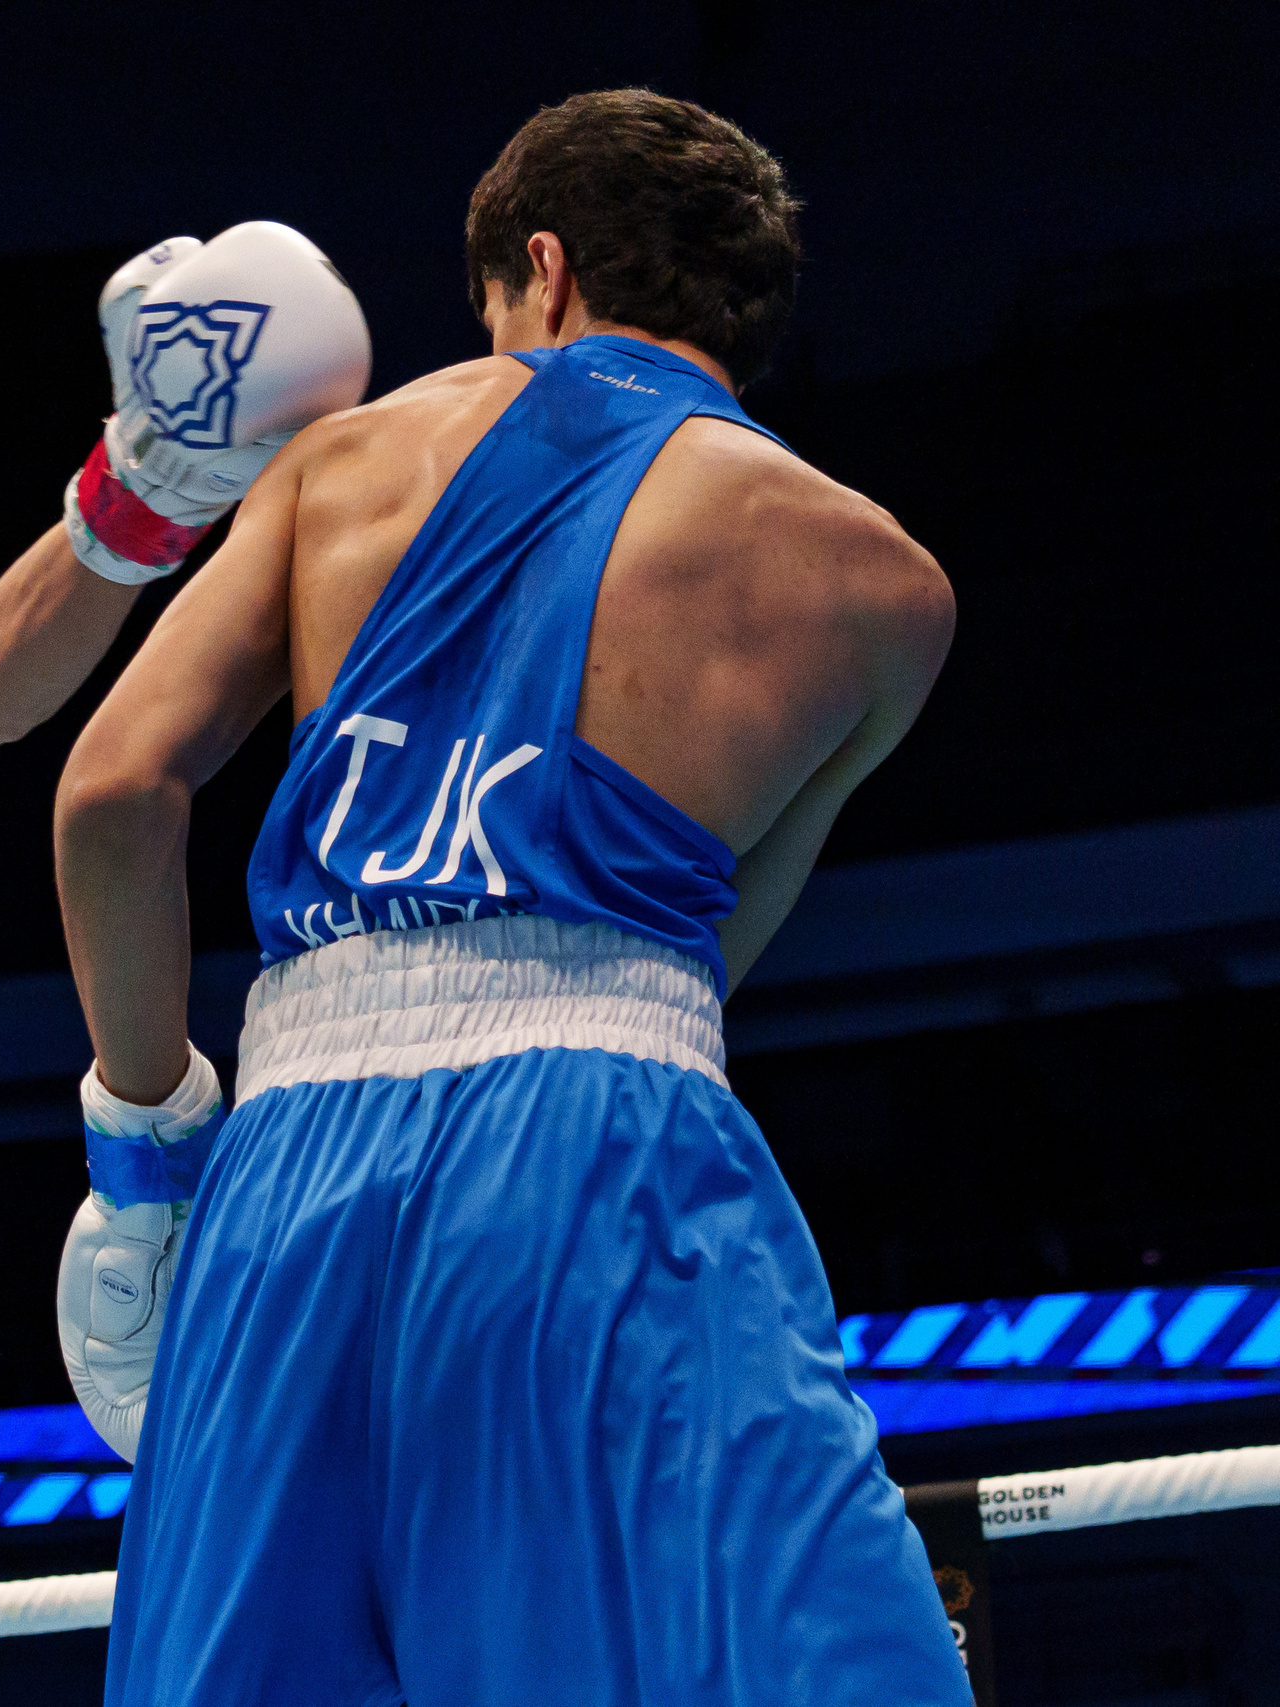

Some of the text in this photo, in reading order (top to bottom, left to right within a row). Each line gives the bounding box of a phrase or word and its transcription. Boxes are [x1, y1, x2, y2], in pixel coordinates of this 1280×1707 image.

[319, 713, 544, 897] TJK
[978, 1484, 1065, 1505] GOLDEN
[981, 1505, 1050, 1525] HOUSE
